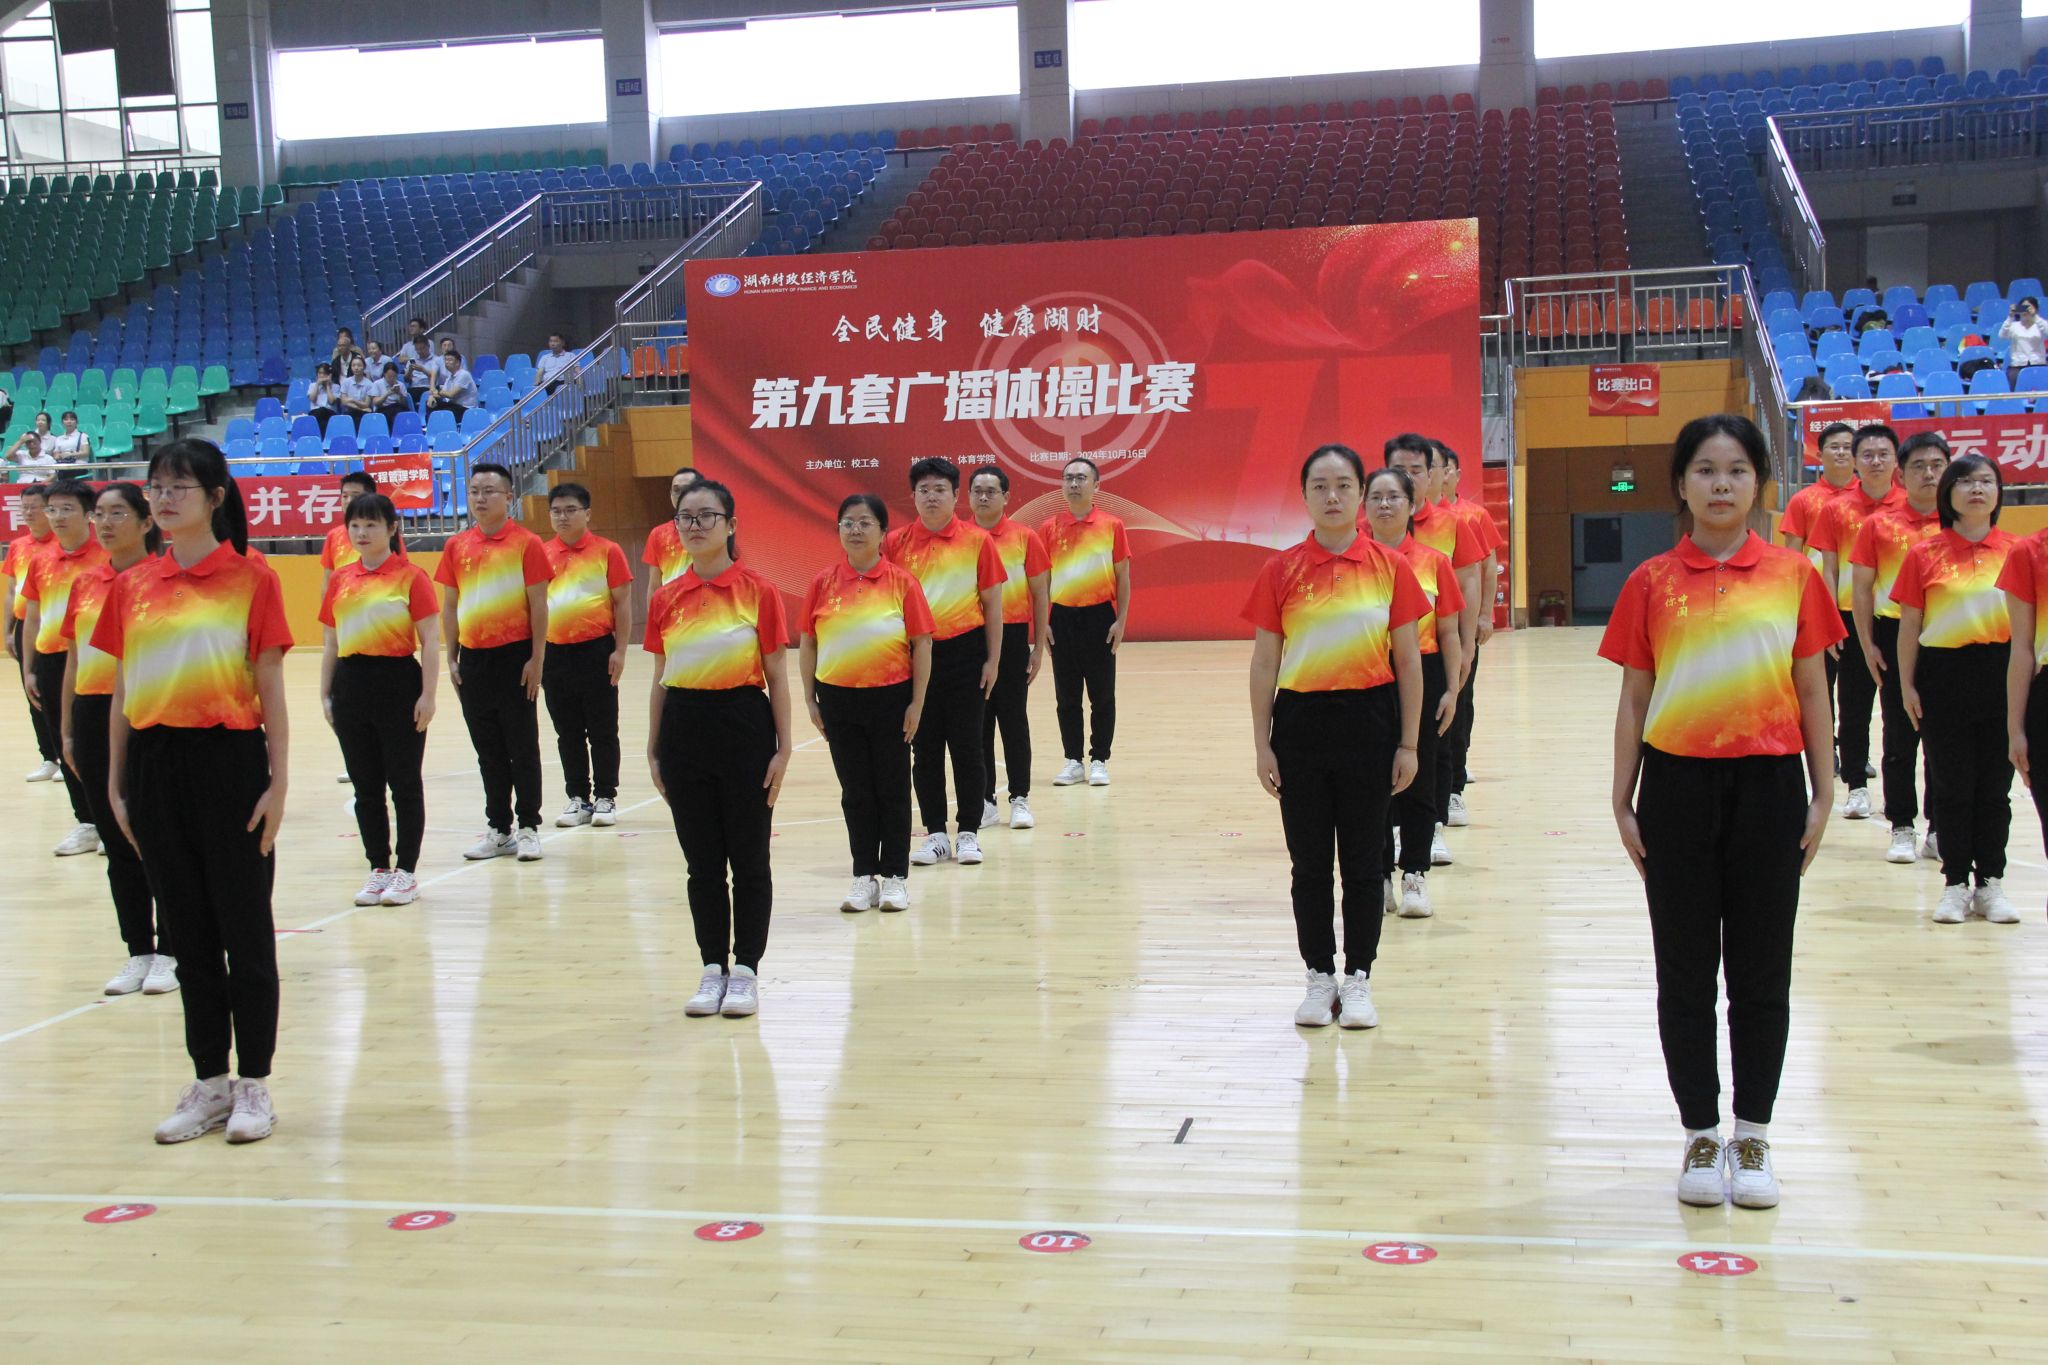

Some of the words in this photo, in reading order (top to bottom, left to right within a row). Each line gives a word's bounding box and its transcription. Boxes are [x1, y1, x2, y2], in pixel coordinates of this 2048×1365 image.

[743, 269, 857, 287] 湖南财政经济学院
[831, 309, 947, 343] 全民健身
[979, 303, 1102, 338] 健康湖财
[1597, 378, 1652, 392] 比赛出口
[749, 361, 1196, 429] 第九套广播体操比赛
[249, 485, 343, 525] 并存
[715, 1225, 744, 1237] 8
[1030, 1234, 1079, 1248] 10
[1375, 1245, 1424, 1260] 12
[1690, 1256, 1744, 1270] 14
